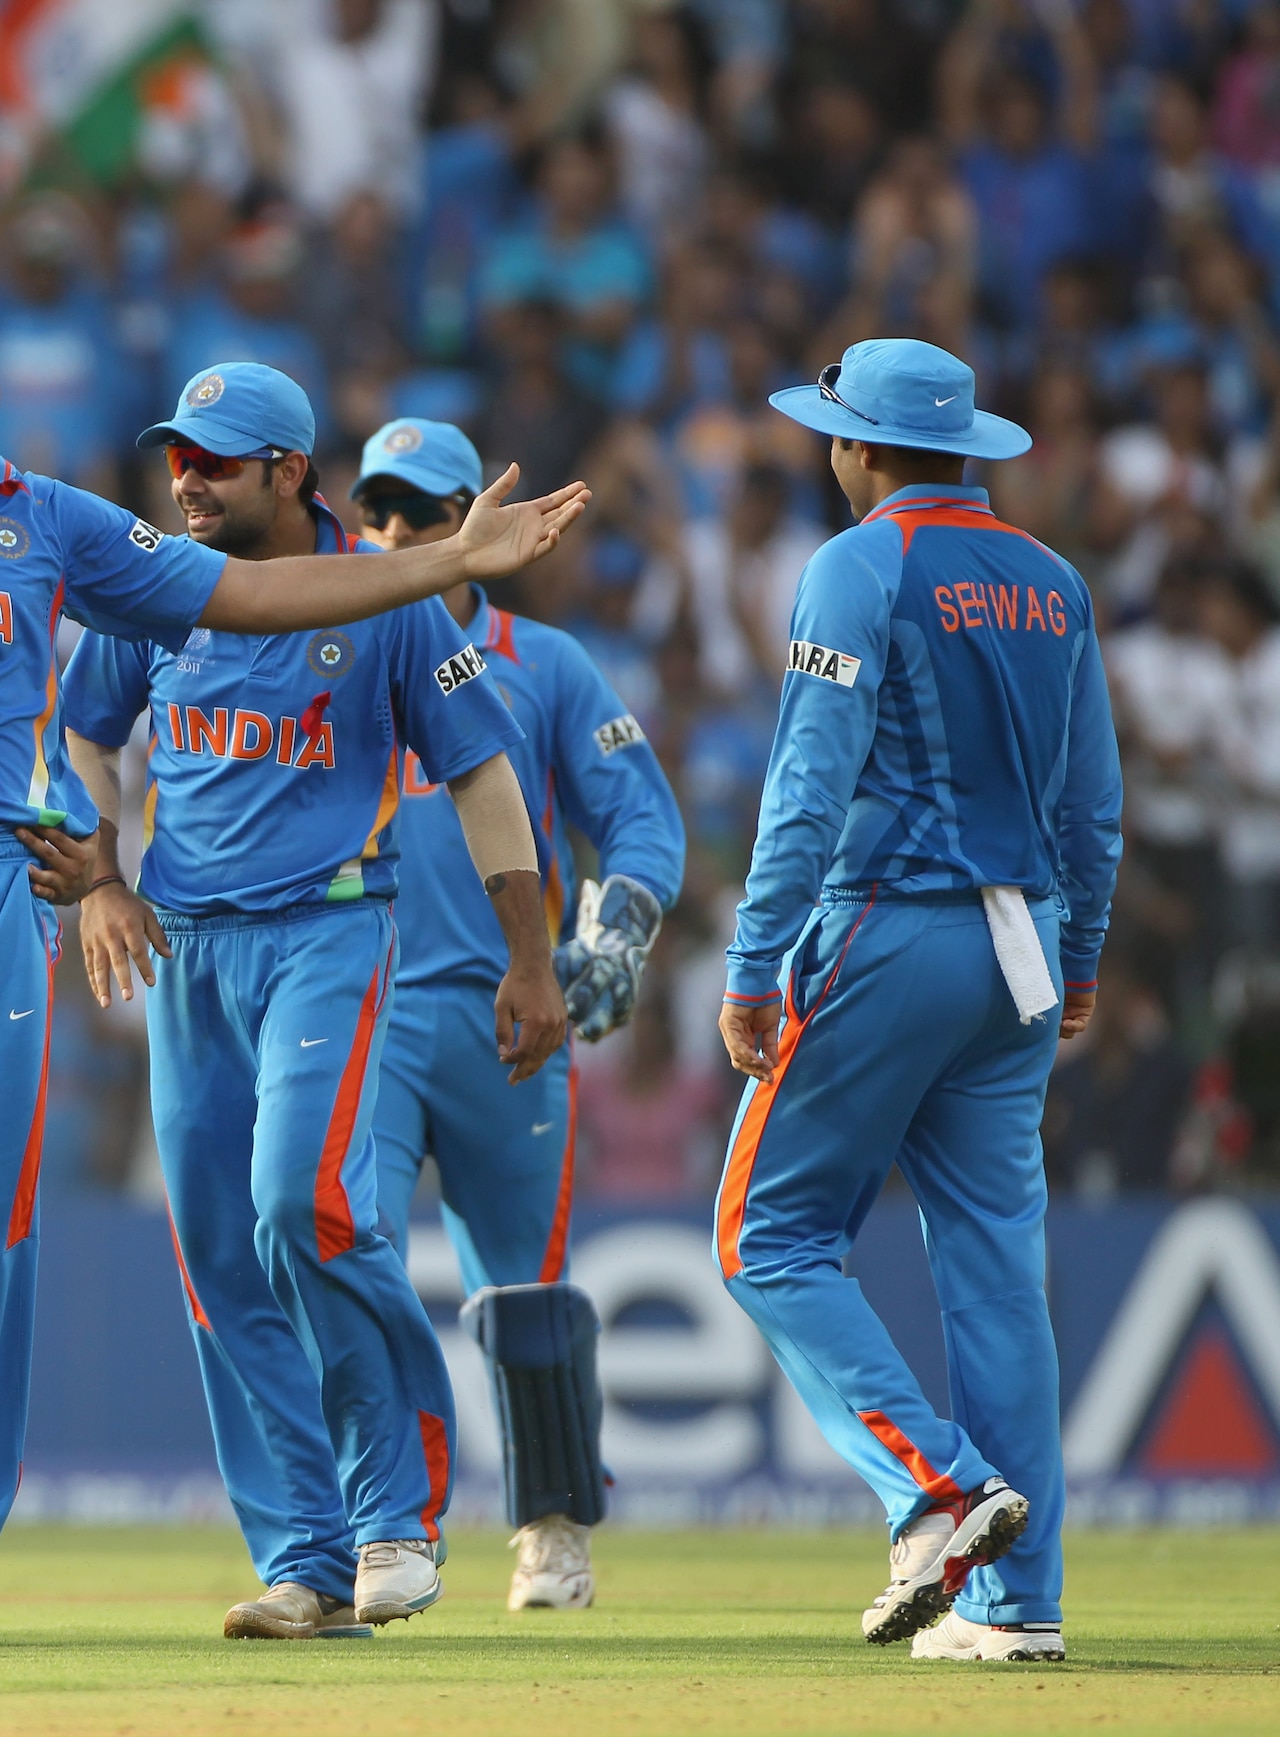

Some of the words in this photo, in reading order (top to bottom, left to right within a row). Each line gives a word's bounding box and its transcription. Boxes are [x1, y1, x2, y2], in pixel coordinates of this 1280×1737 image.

[934, 581, 1067, 637] SEHWAG
[176, 660, 200, 675] 2011
[167, 701, 336, 770] INDIA
